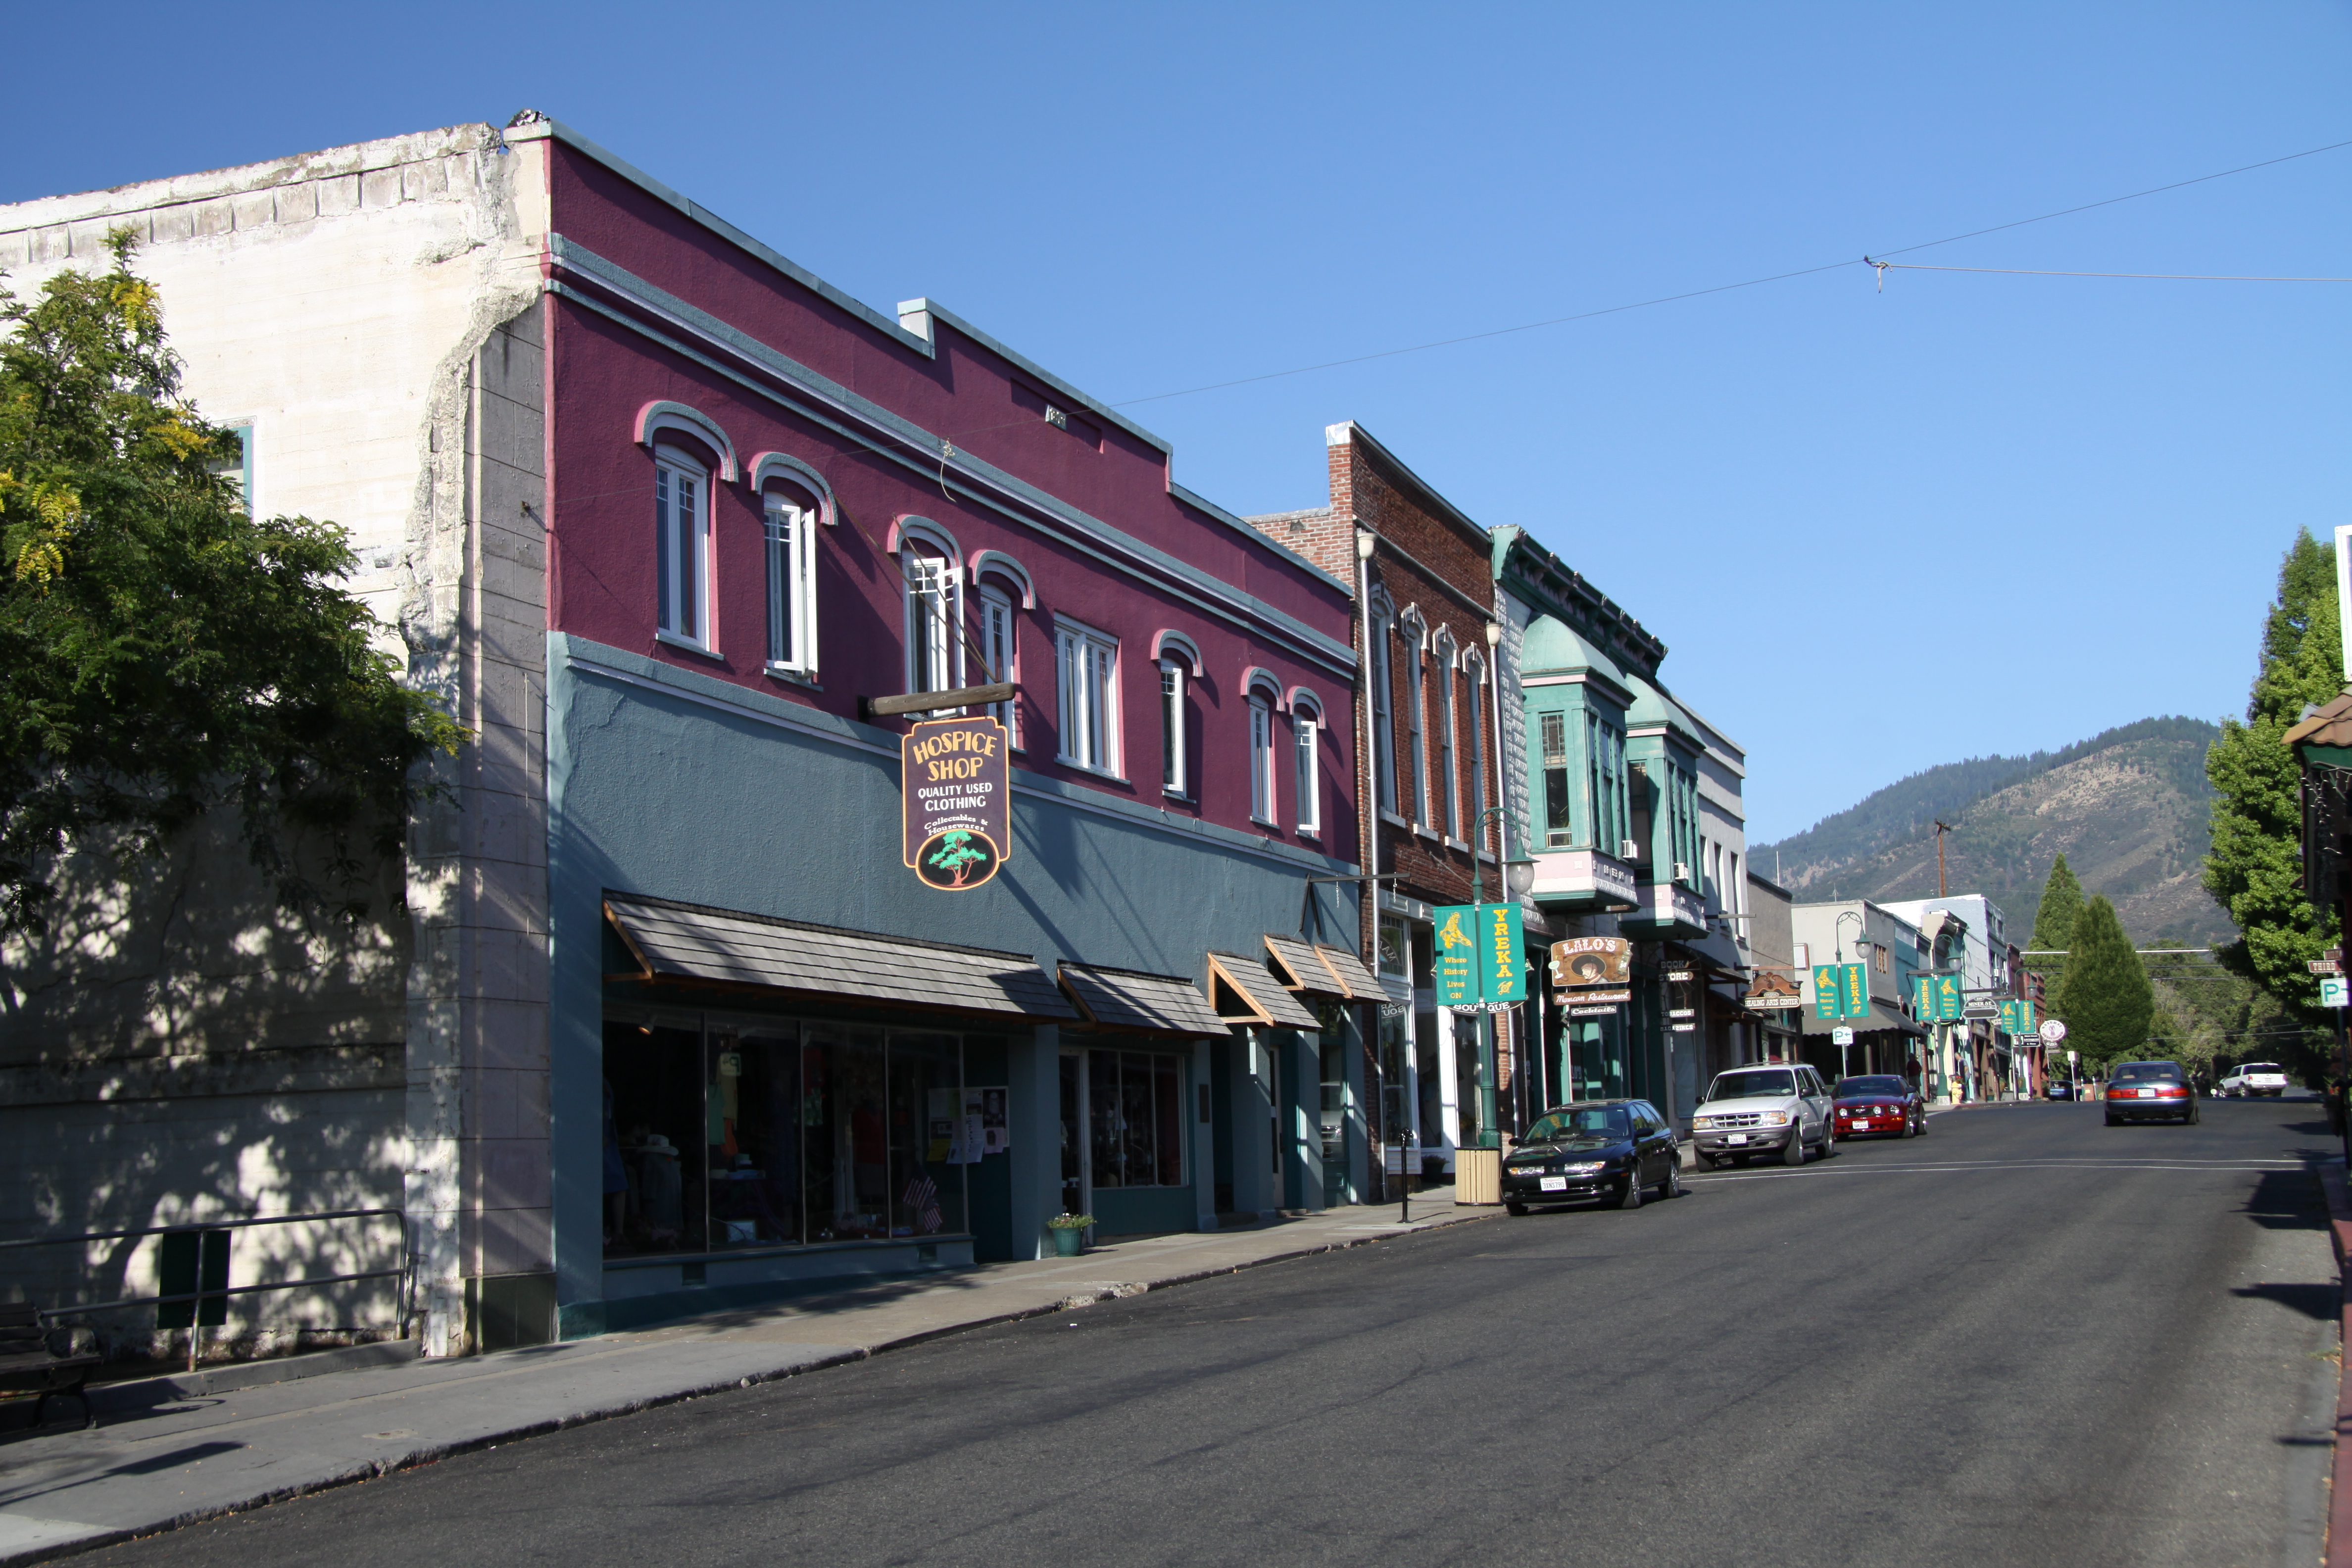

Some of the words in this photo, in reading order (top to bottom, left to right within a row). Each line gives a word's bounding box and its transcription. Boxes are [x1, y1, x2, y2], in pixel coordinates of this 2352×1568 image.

[913, 731, 997, 765] HOSPICE
[928, 757, 983, 782] SHOP
[918, 784, 962, 799] QUALITY
[966, 782, 992, 794] USED
[925, 795, 986, 812] CLOTHING
[924, 814, 976, 830] Collectables
[928, 823, 984, 836] Housewares
[1493, 909, 1514, 978] YREKA
[1562, 938, 1616, 955] LALO'S
[1661, 960, 1684, 969] BOOK
[2312, 962, 2335, 971] THIRD
[1659, 972, 1688, 981] STORE
[1849, 967, 1861, 1005] YREKA
[1921, 980, 1930, 1009] YREKA
[2323, 983, 2347, 1002] PARKI
[1588, 991, 1629, 1001] Restaurant
[1453, 1001, 1510, 1012] BOUQUE
